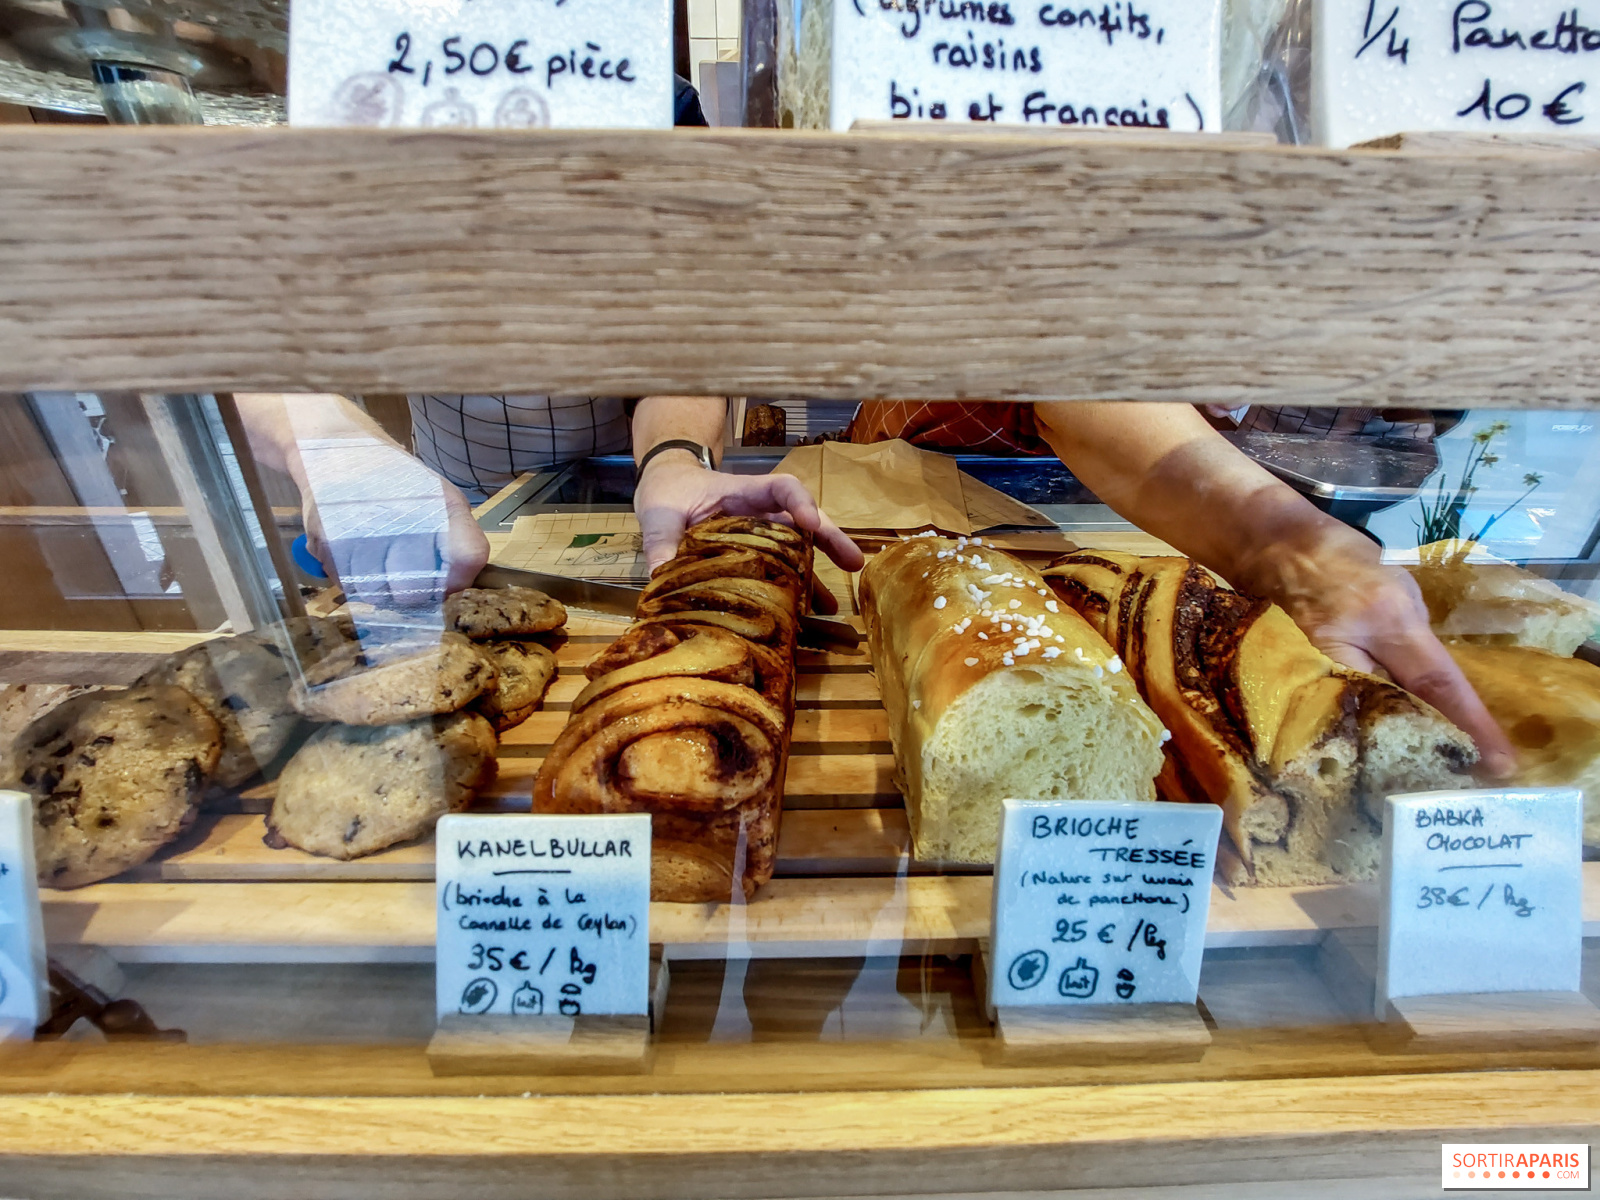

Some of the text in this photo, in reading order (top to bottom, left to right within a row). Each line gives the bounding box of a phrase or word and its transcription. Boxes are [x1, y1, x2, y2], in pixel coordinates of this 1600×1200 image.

[1039, 1, 1164, 45] confits,
[388, 32, 636, 88] 2,50€ pièce
[932, 30, 1043, 73] raisins
[891, 81, 947, 120] bio
[968, 94, 1002, 121] et
[1032, 815, 1139, 839] BRIOCHE
[1416, 808, 1484, 828] BABKA
[457, 838, 633, 859] KANELBULLAR
[1089, 839, 1206, 868] TRESSÉE
[1426, 833, 1533, 852] CHOCOLAT
[1021, 871, 1091, 887] (Nature
[1102, 873, 1132, 884] sur
[443, 880, 587, 911] (brioche à la
[1057, 894, 1080, 905] de
[542, 913, 563, 930] de
